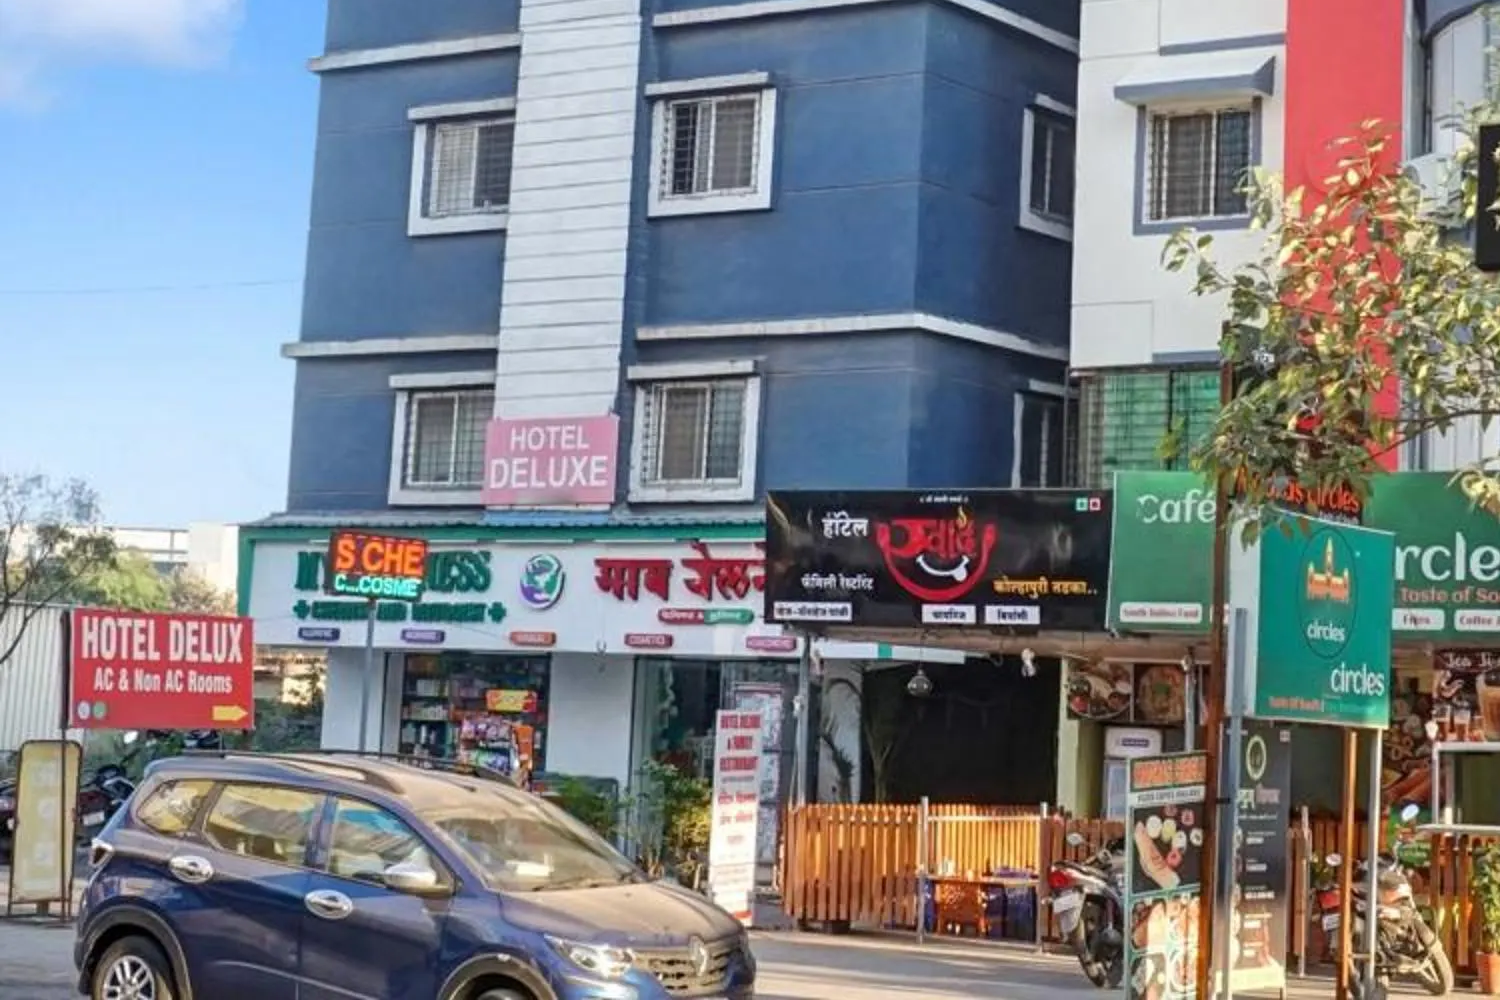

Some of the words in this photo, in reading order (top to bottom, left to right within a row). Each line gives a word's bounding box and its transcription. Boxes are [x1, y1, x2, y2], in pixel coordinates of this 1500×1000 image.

[510, 424, 591, 453] HOTEL
[489, 455, 609, 489] DELUXE
[1136, 487, 1217, 524] Café
[360, 542, 424, 577] CHE
[1401, 586, 1447, 603] Taste
[1452, 586, 1474, 603] of
[81, 615, 160, 662] HOTEL
[168, 619, 244, 664] DELUX
[1306, 618, 1345, 642] circles
[94, 667, 115, 691] AC
[118, 667, 130, 692] &
[133, 667, 161, 692] Non
[164, 668, 185, 693] AC
[188, 669, 233, 694] Rooms
[1331, 661, 1385, 697] circles
